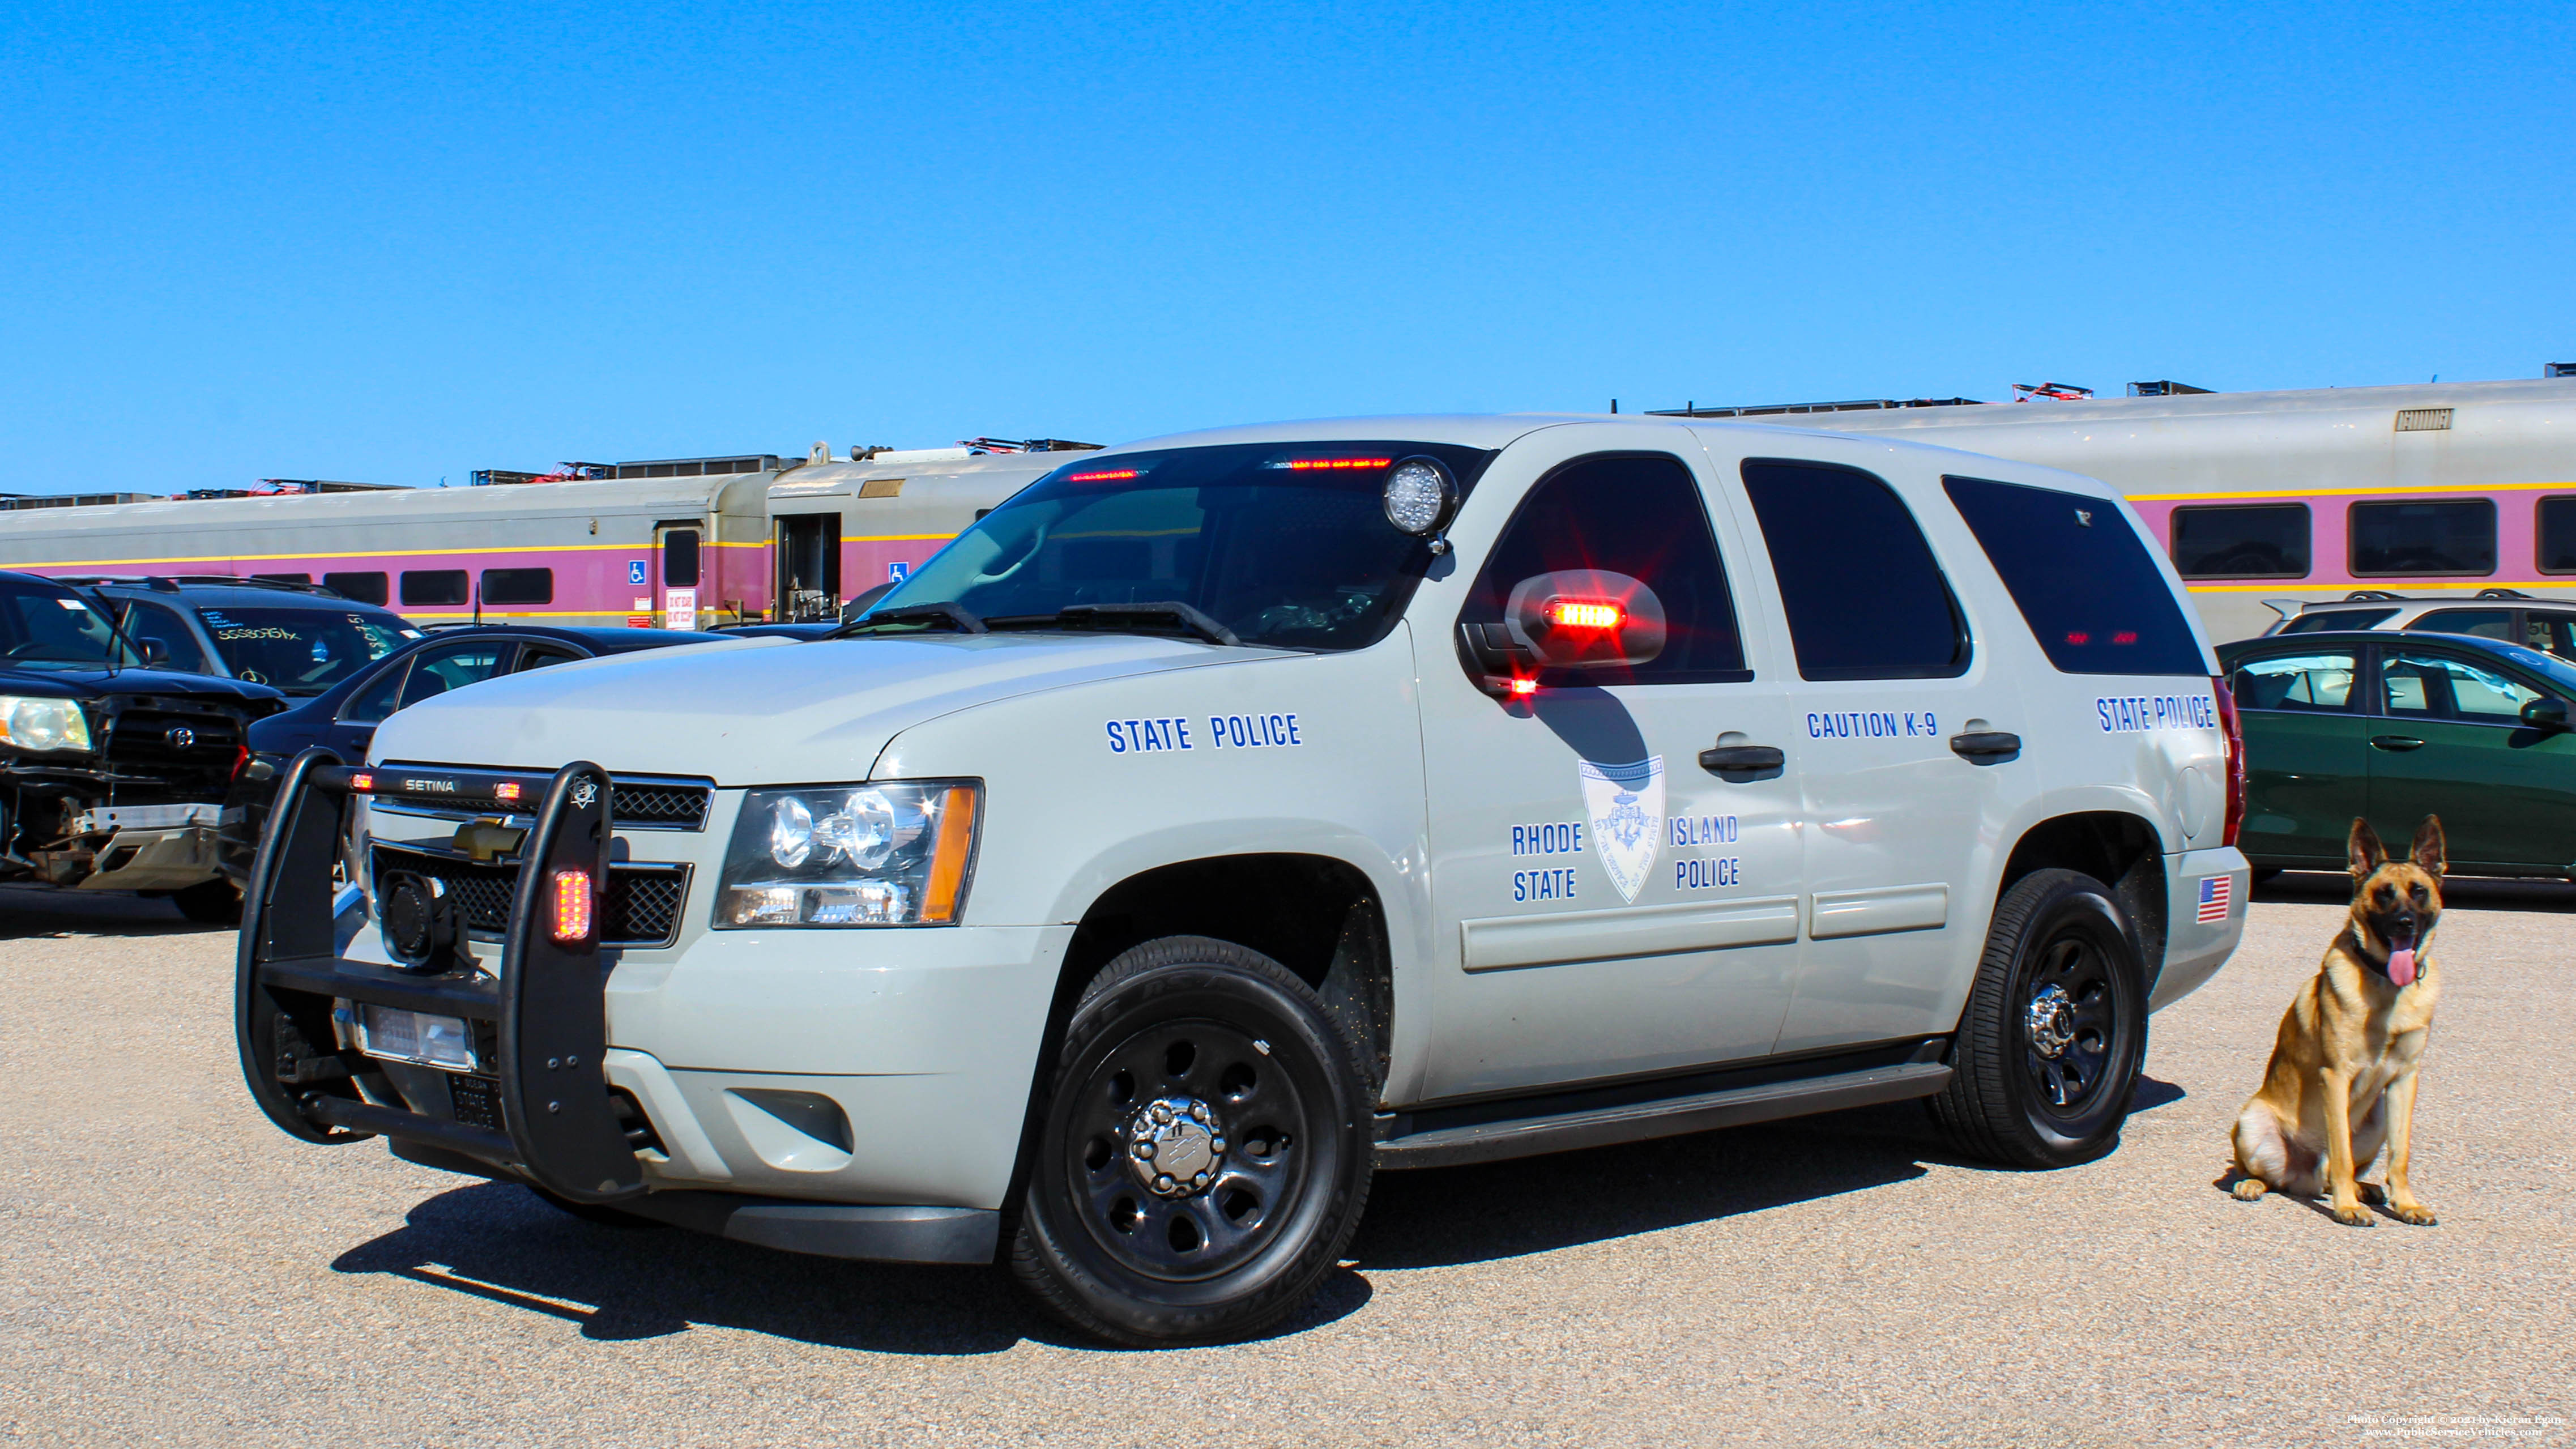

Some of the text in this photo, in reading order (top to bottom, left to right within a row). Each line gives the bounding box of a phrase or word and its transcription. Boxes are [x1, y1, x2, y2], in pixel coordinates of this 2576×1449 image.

[1106, 713, 1302, 754] STATE POLICE
[1806, 711, 1938, 739] CAUTION K-9
[2096, 695, 2215, 734] STATE POLICE
[406, 779, 455, 792] SETINA
[1512, 814, 1738, 856] RHODE ISLAND
[1513, 857, 1739, 903] STATE POLICE
[456, 1090, 489, 1110] STATE
